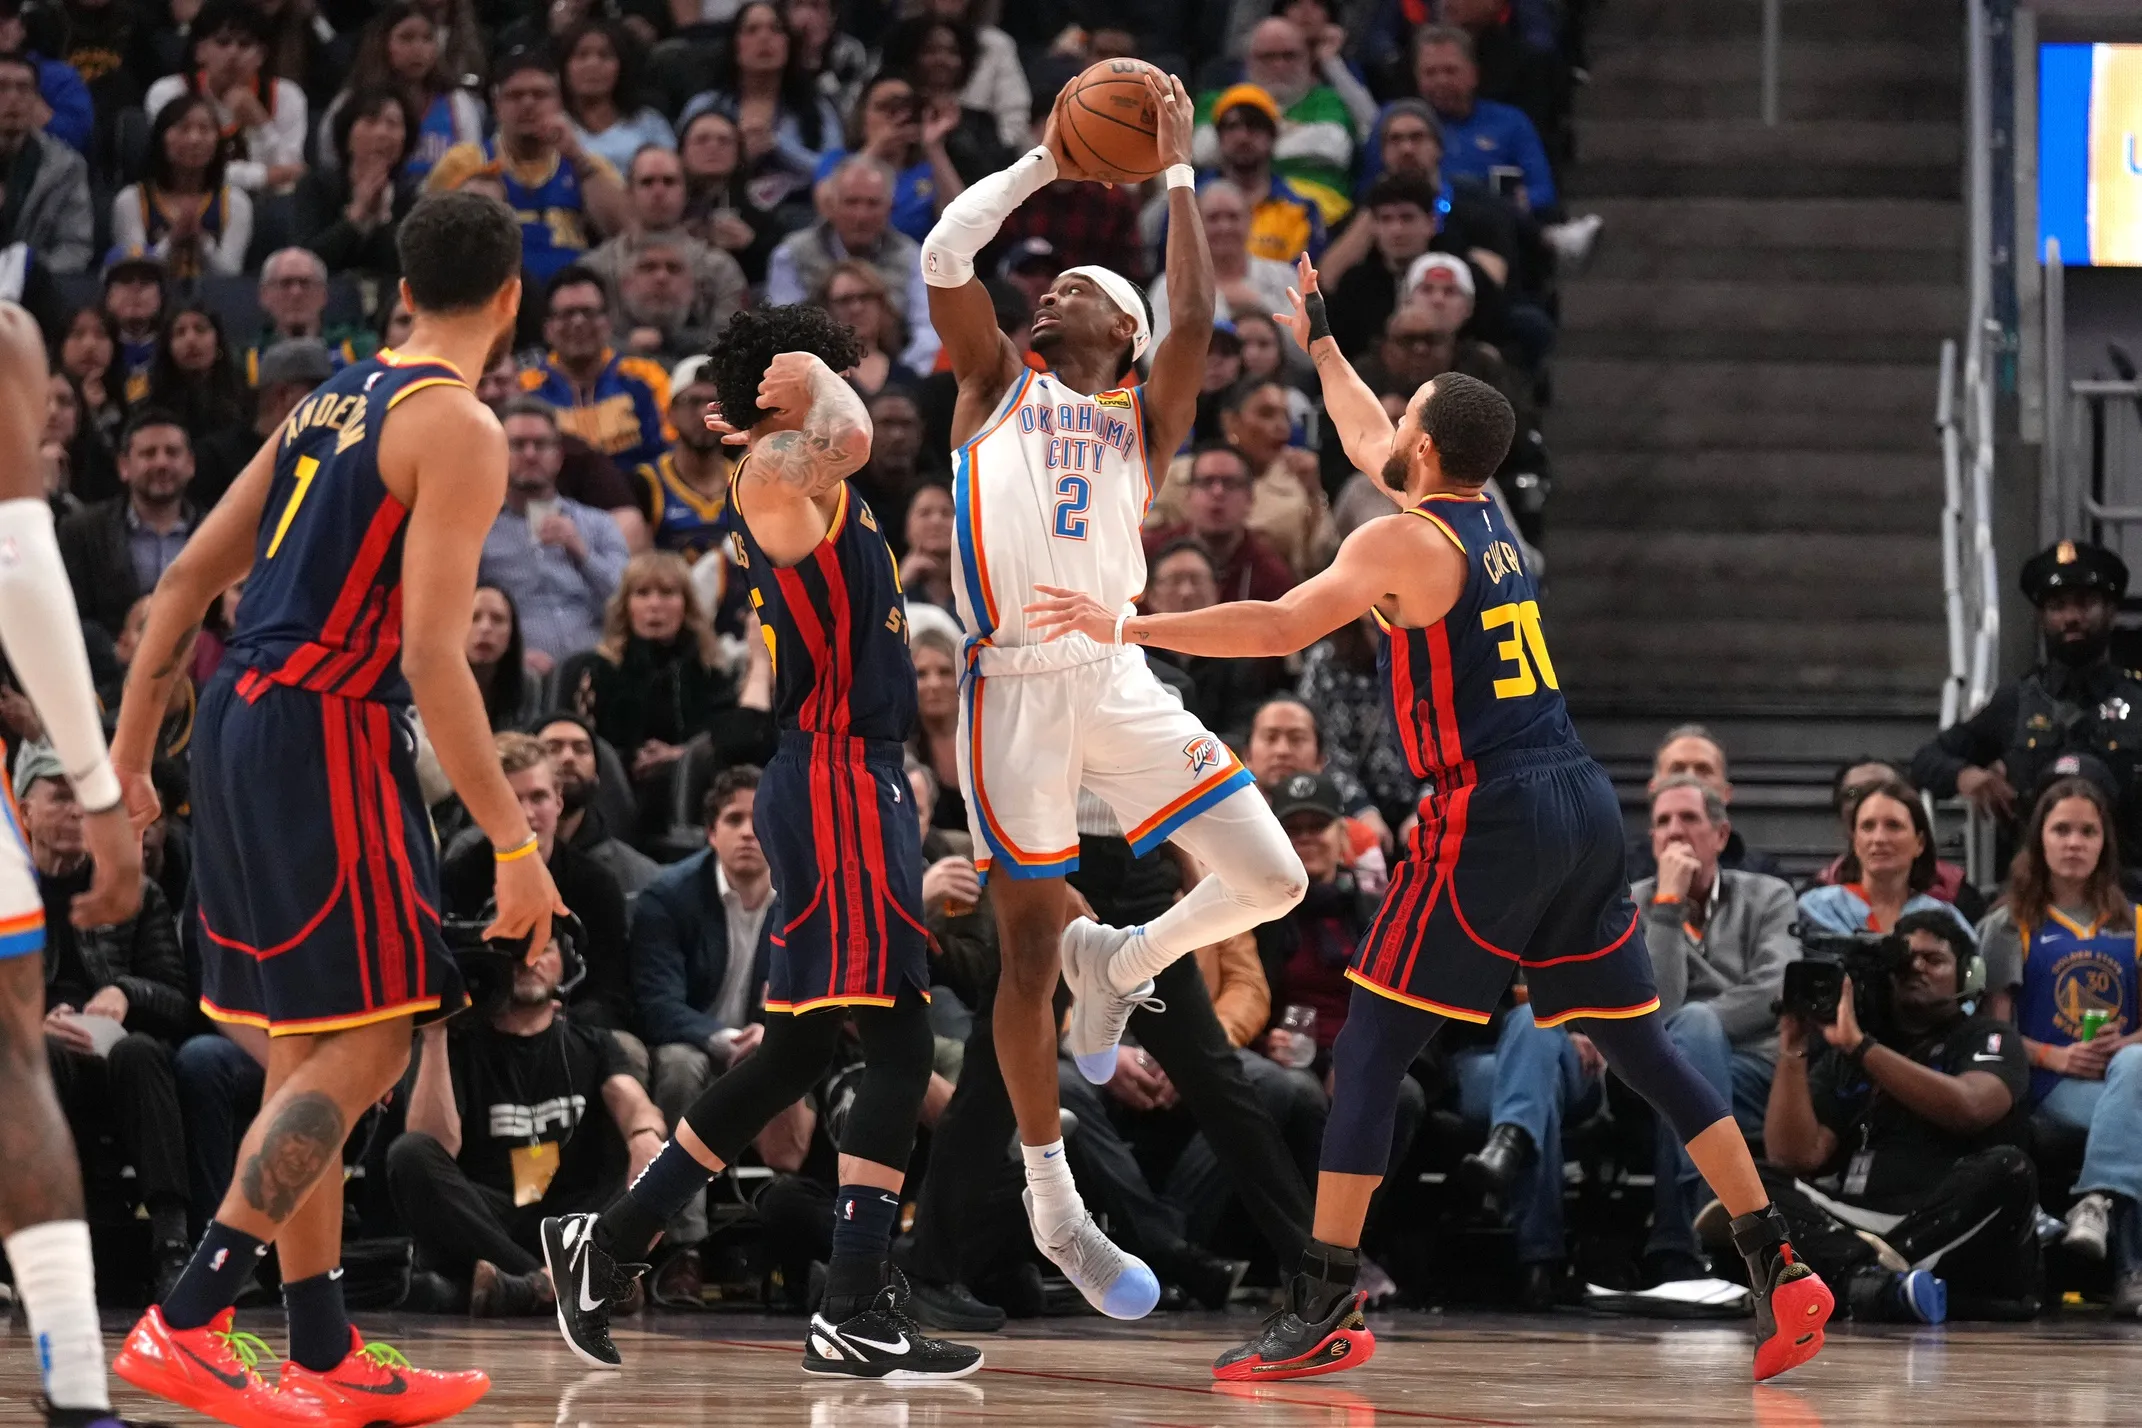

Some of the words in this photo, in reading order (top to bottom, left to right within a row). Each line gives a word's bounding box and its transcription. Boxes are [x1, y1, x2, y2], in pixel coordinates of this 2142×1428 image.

[1018, 403, 1136, 462] OKAHOMA
[1046, 436, 1106, 474] CITY
[265, 453, 320, 559] 1
[1052, 473, 1092, 542] 2
[1480, 600, 1559, 700] 30
[1193, 740, 1213, 771] OKC
[2087, 971, 2109, 992] 30
[488, 1094, 587, 1138] ESPN
[825, 1345, 833, 1358] 2
